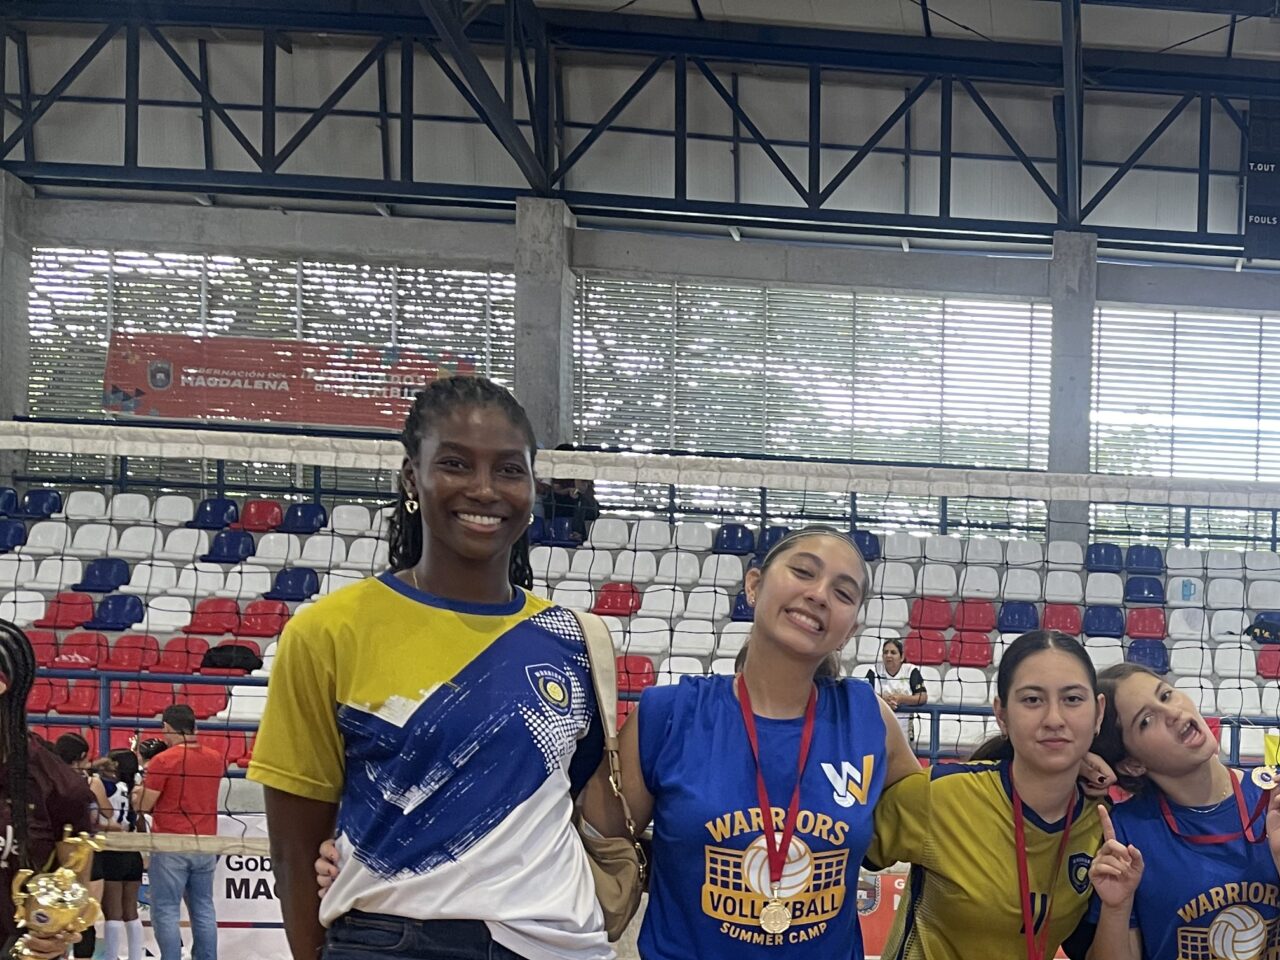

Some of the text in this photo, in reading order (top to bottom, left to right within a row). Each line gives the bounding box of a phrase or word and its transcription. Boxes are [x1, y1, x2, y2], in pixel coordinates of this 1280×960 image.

[1249, 162, 1276, 172] T.OUT
[1249, 215, 1278, 225] FOULS
[180, 374, 290, 391] MAGDALENA
[705, 806, 850, 846] WARRORS
[709, 890, 840, 920] VOLLBALL
[719, 921, 828, 946] SUMMER CAMP
